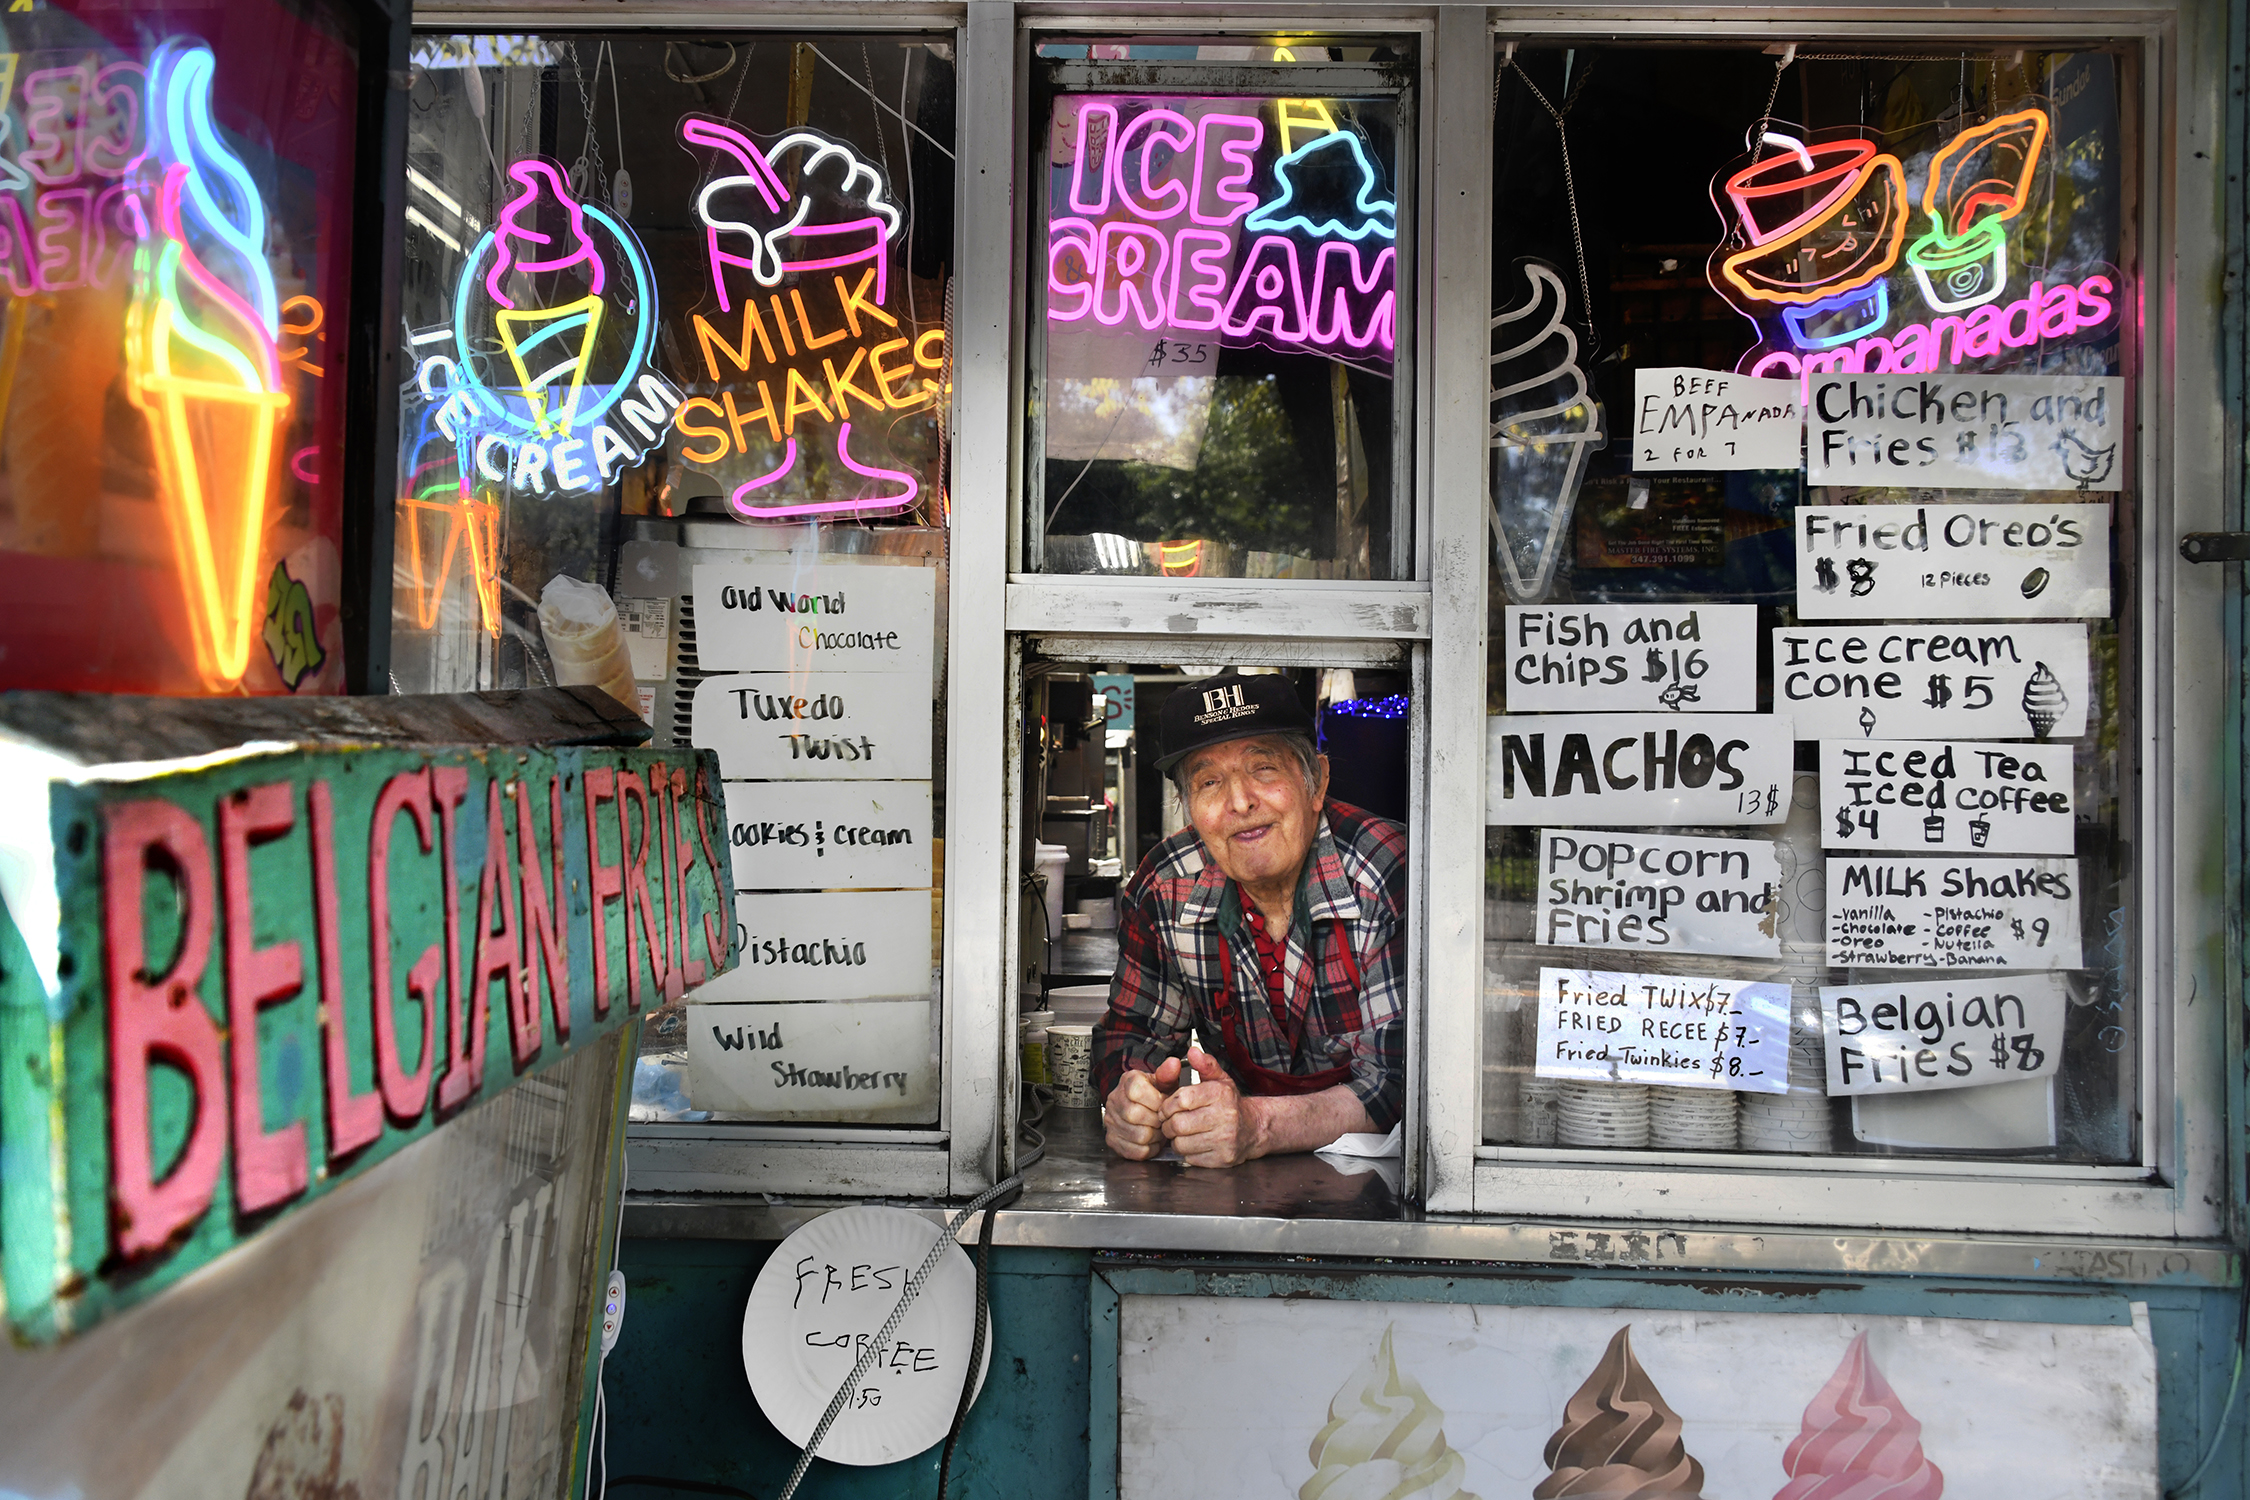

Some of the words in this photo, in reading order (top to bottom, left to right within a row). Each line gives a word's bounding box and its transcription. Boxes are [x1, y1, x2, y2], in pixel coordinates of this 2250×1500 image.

[1068, 102, 1264, 227] ICE
[1047, 216, 1395, 349] CREAM
[692, 267, 898, 382] MILK
[1148, 339, 1207, 367] $35
[675, 329, 953, 464] SHAKES
[1673, 374, 1728, 398] BEEF
[1816, 380, 2008, 425] Chicken
[2029, 386, 2107, 427] and
[410, 328, 482, 443] ICE
[475, 374, 681, 494] CREAM
[1639, 395, 1796, 440] EMPANADA
[1644, 448, 1660, 462] 2
[1673, 447, 1707, 462] FOR
[1724, 441, 1736, 456] 7
[1822, 428, 1940, 469] Fries
[1652, 477, 1670, 485] Your
[1672, 524, 1690, 532] FREE
[1806, 507, 1930, 554] Fried
[1943, 512, 2085, 548] Oreo's
[1607, 546, 1641, 555] MASTER
[1642, 546, 1661, 555] FIRE
[1701, 545, 1720, 554] INC.
[1631, 554, 1696, 564] 347.391.1099
[1921, 572, 1936, 589] 12
[720, 585, 762, 612] Old
[767, 588, 846, 615] World
[798, 625, 902, 650] Chocolate
[1518, 611, 1609, 648] Fish
[1622, 610, 1701, 645] and
[1514, 651, 1629, 687] Chips
[1641, 647, 1710, 683] $16
[1922, 673, 1995, 710] $5
[778, 733, 876, 761] Twist
[1500, 728, 1751, 800] NACHOS
[1842, 744, 1957, 779] Iced
[1974, 751, 2048, 783] Tea
[1737, 784, 1780, 818] 13$
[1844, 780, 1947, 810] Iced
[729, 822, 810, 848] ookies
[1835, 805, 1880, 840] $4
[1549, 836, 1750, 881] Popcorn
[1548, 878, 1686, 919] Shrimp
[1695, 882, 1773, 915] and
[1940, 867, 2072, 900] Shakes
[1548, 907, 1671, 945] Fries
[2010, 916, 2050, 948] $9
[100, 764, 571, 1260] BELGIAN
[582, 760, 730, 1018] FRIES
[1557, 978, 1628, 1007] Fried
[1557, 1010, 1623, 1034] FRIED
[1641, 1017, 1708, 1041] RECEE
[1836, 991, 2026, 1045] Belgian
[711, 1021, 784, 1052] Wild
[1555, 1040, 1609, 1061] Fried
[1618, 1046, 1701, 1069] Twinkies
[770, 1060, 908, 1097] Strawberry
[1839, 1041, 1973, 1085] Fries
